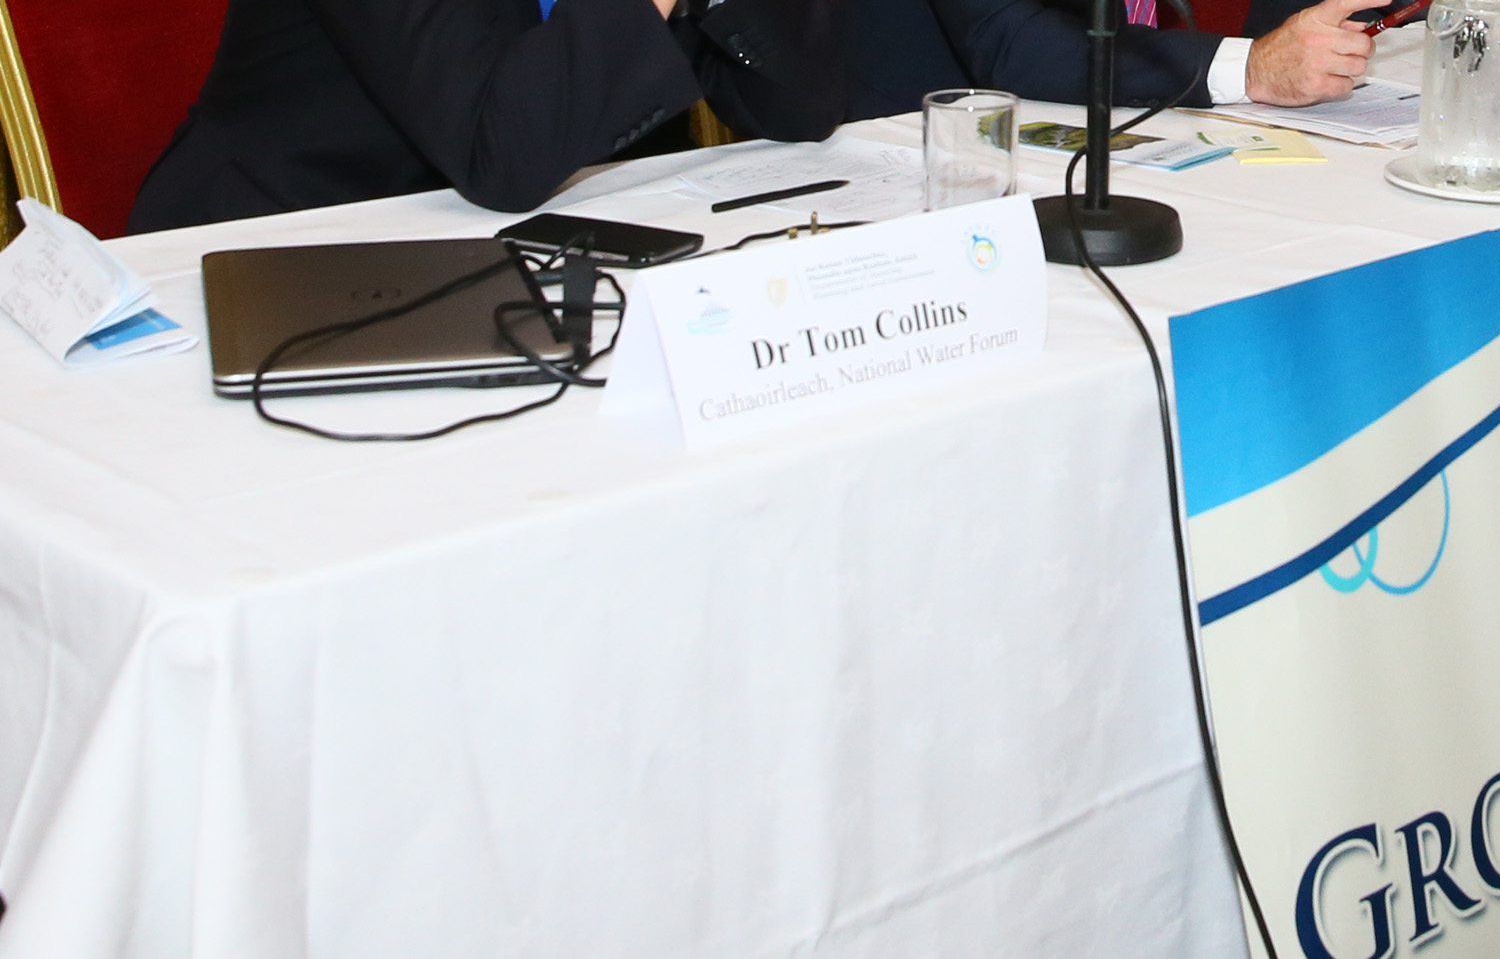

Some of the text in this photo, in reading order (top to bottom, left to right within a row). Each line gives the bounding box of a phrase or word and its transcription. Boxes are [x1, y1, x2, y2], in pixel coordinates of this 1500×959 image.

[698, 327, 1019, 421] Cathaoirleach, National Water Forum
[749, 300, 968, 370] Dr Tom Collins
